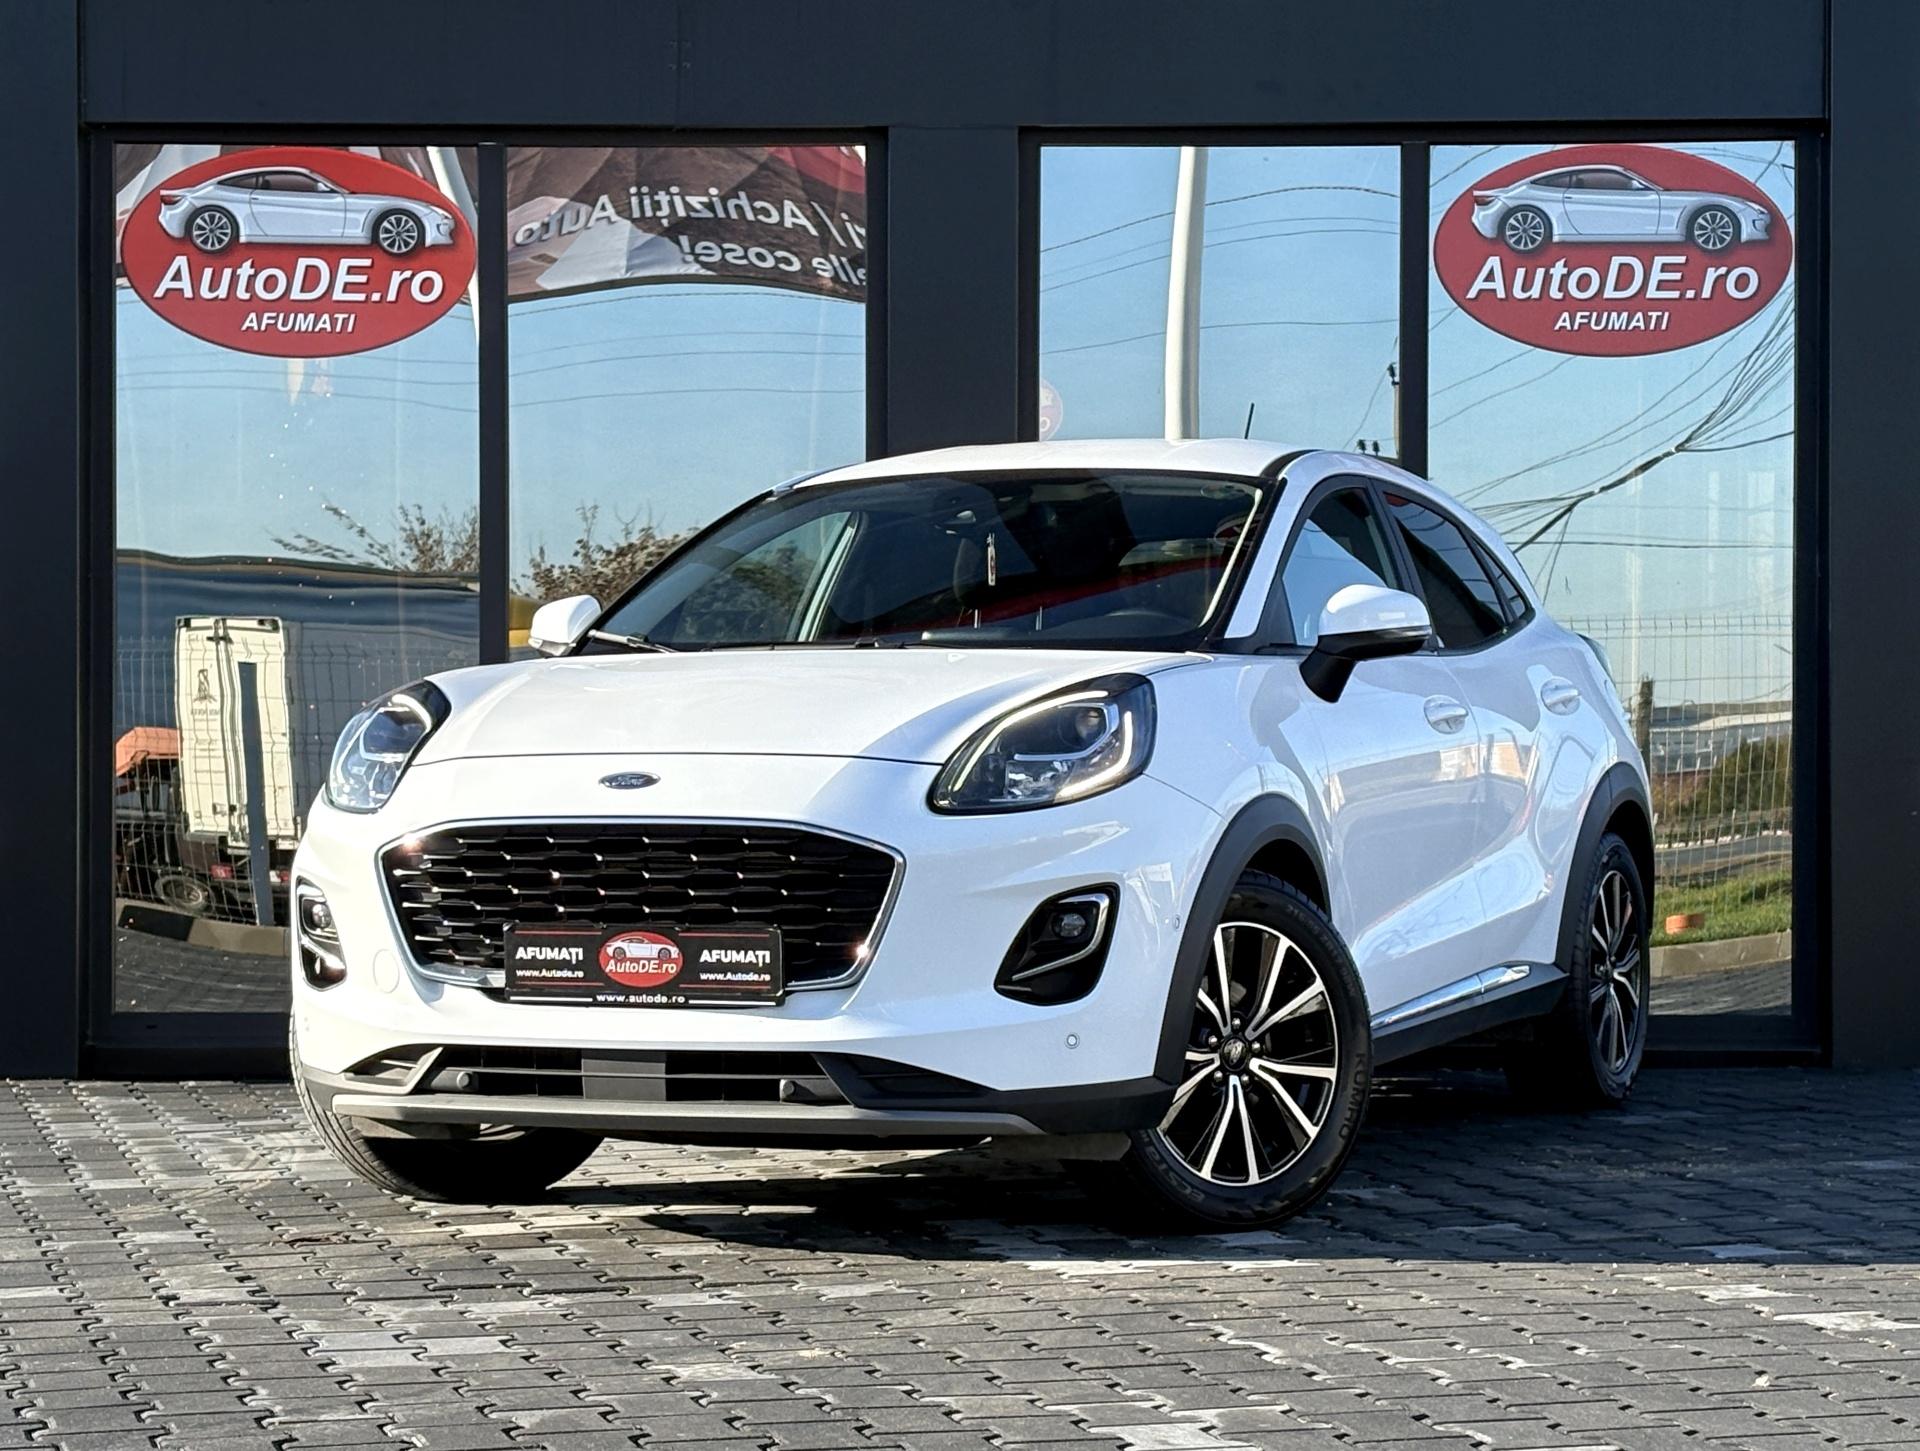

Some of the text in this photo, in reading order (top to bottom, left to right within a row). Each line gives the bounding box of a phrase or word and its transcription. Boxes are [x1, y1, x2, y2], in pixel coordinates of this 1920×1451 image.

[153, 255, 444, 303] AutoDE.ro
[1466, 255, 1760, 301] AutoDE.ro
[241, 312, 357, 333] AFUMATI
[1554, 311, 1670, 331] AFUMATI
[515, 968, 584, 978] www.Autode.ro
[605, 959, 677, 974] AutoDE.ro
[699, 972, 771, 981] www.Autode.ro
[596, 993, 686, 1004] www.autode.ro
[1337, 1053, 1366, 1141] KUMHO
